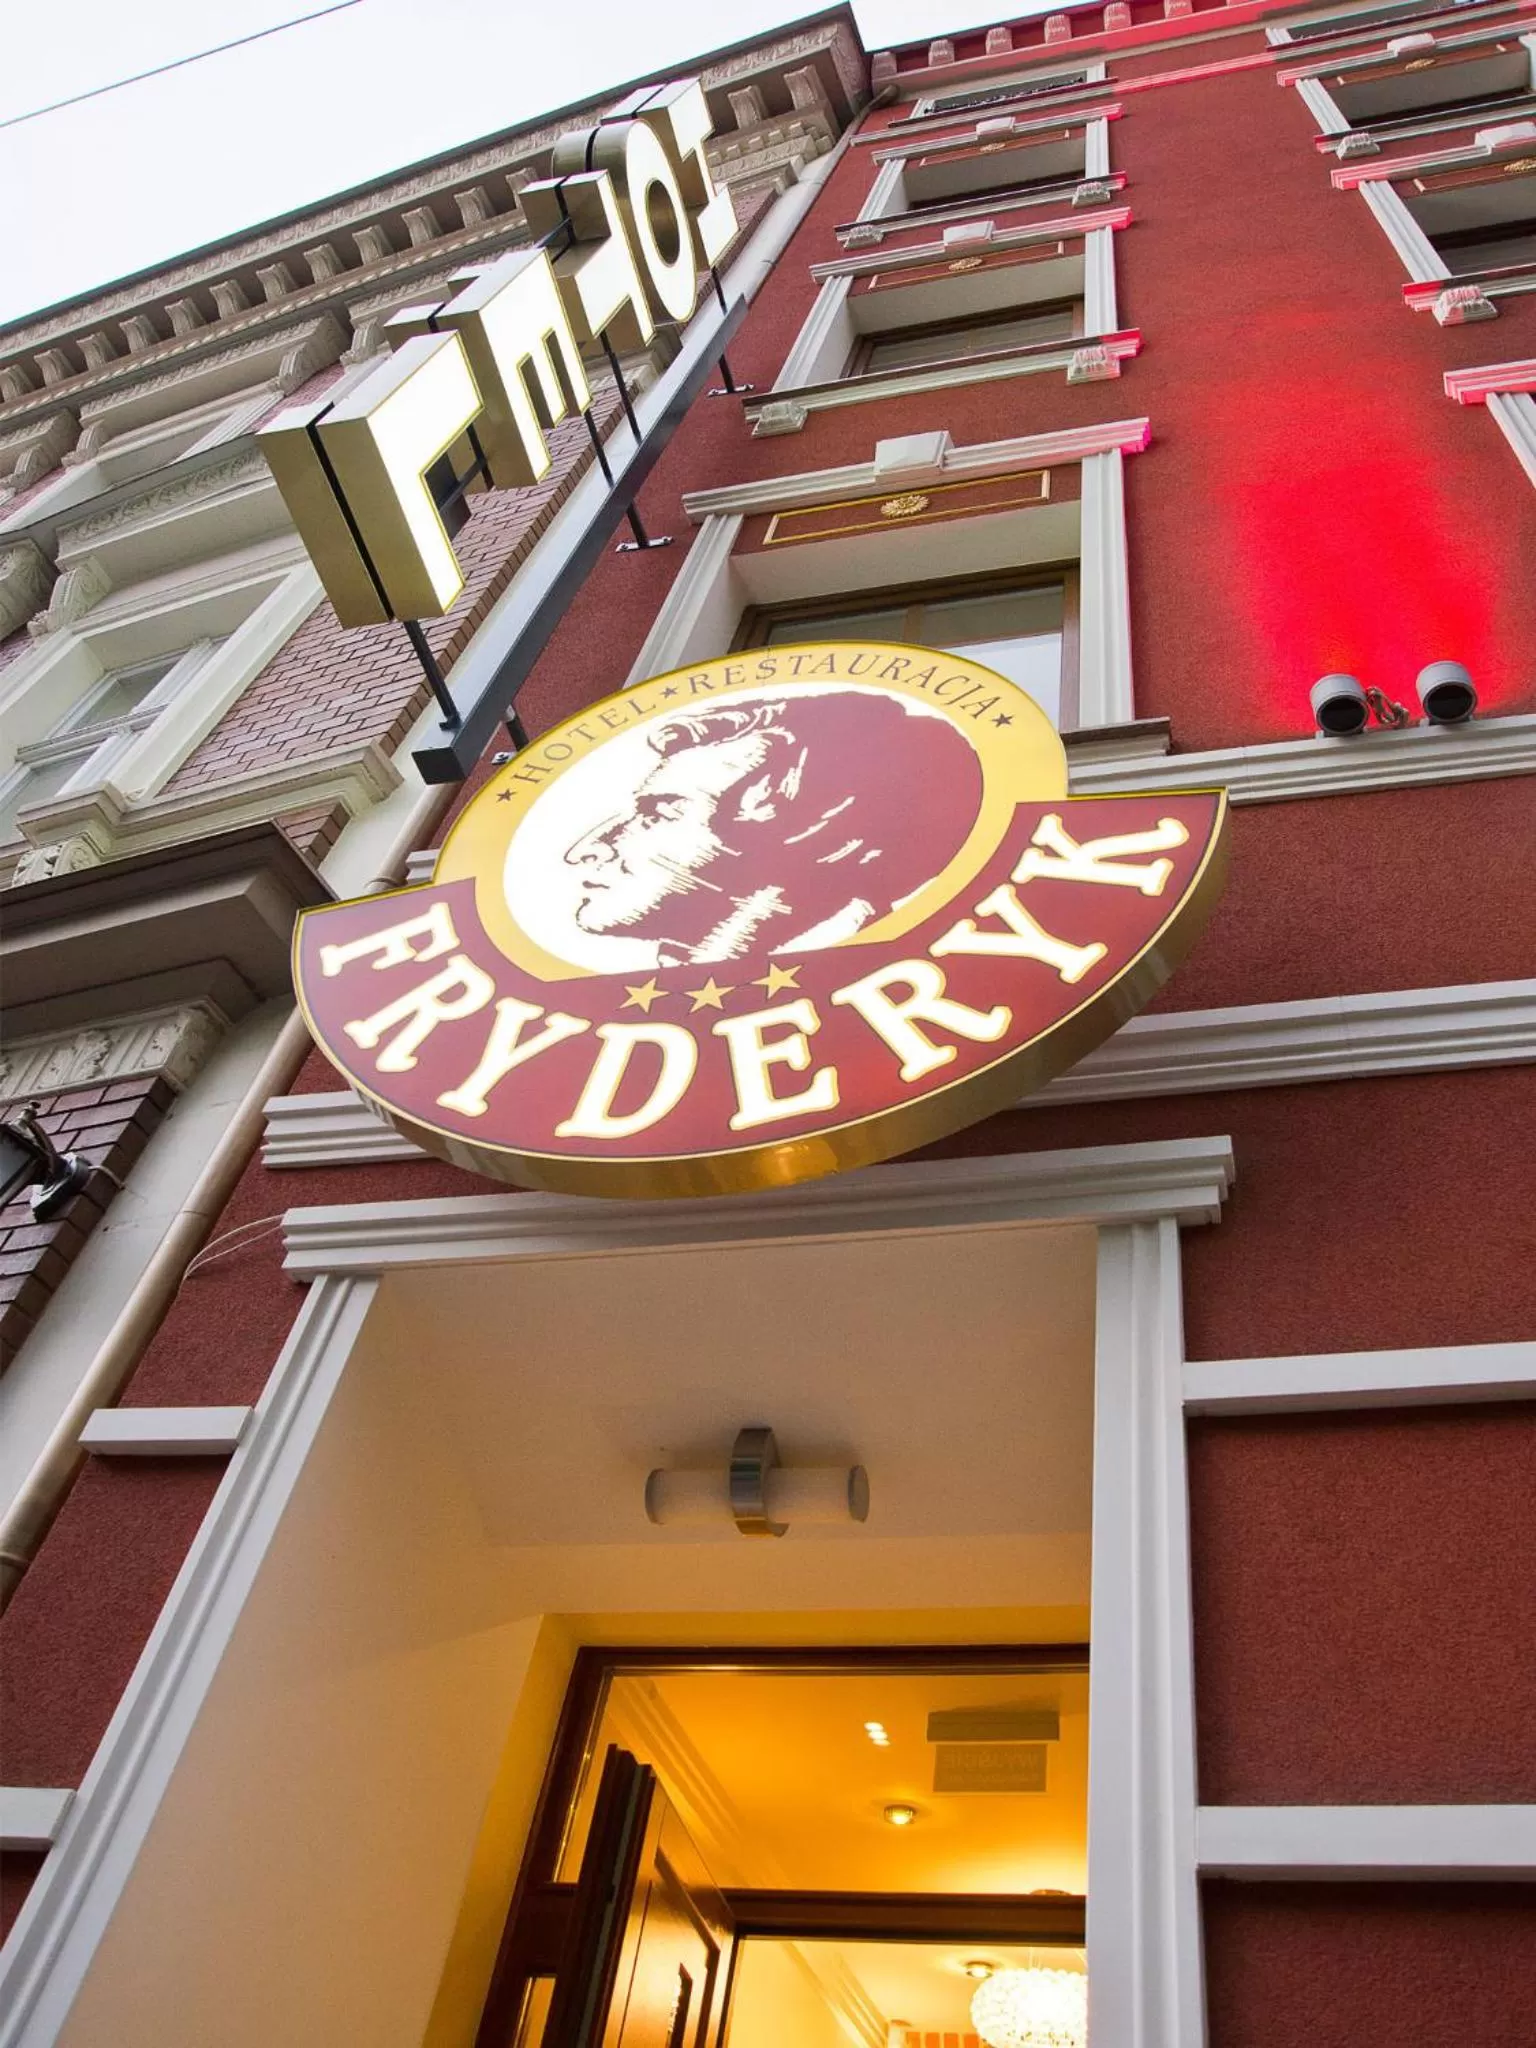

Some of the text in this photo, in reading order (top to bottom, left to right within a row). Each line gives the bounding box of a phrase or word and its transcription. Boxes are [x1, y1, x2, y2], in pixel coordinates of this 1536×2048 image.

[365, 79, 740, 616] HOTEL
[512, 653, 1000, 785] HOTEL RESTAURACJA
[319, 813, 1190, 1139] FRYDERYK
